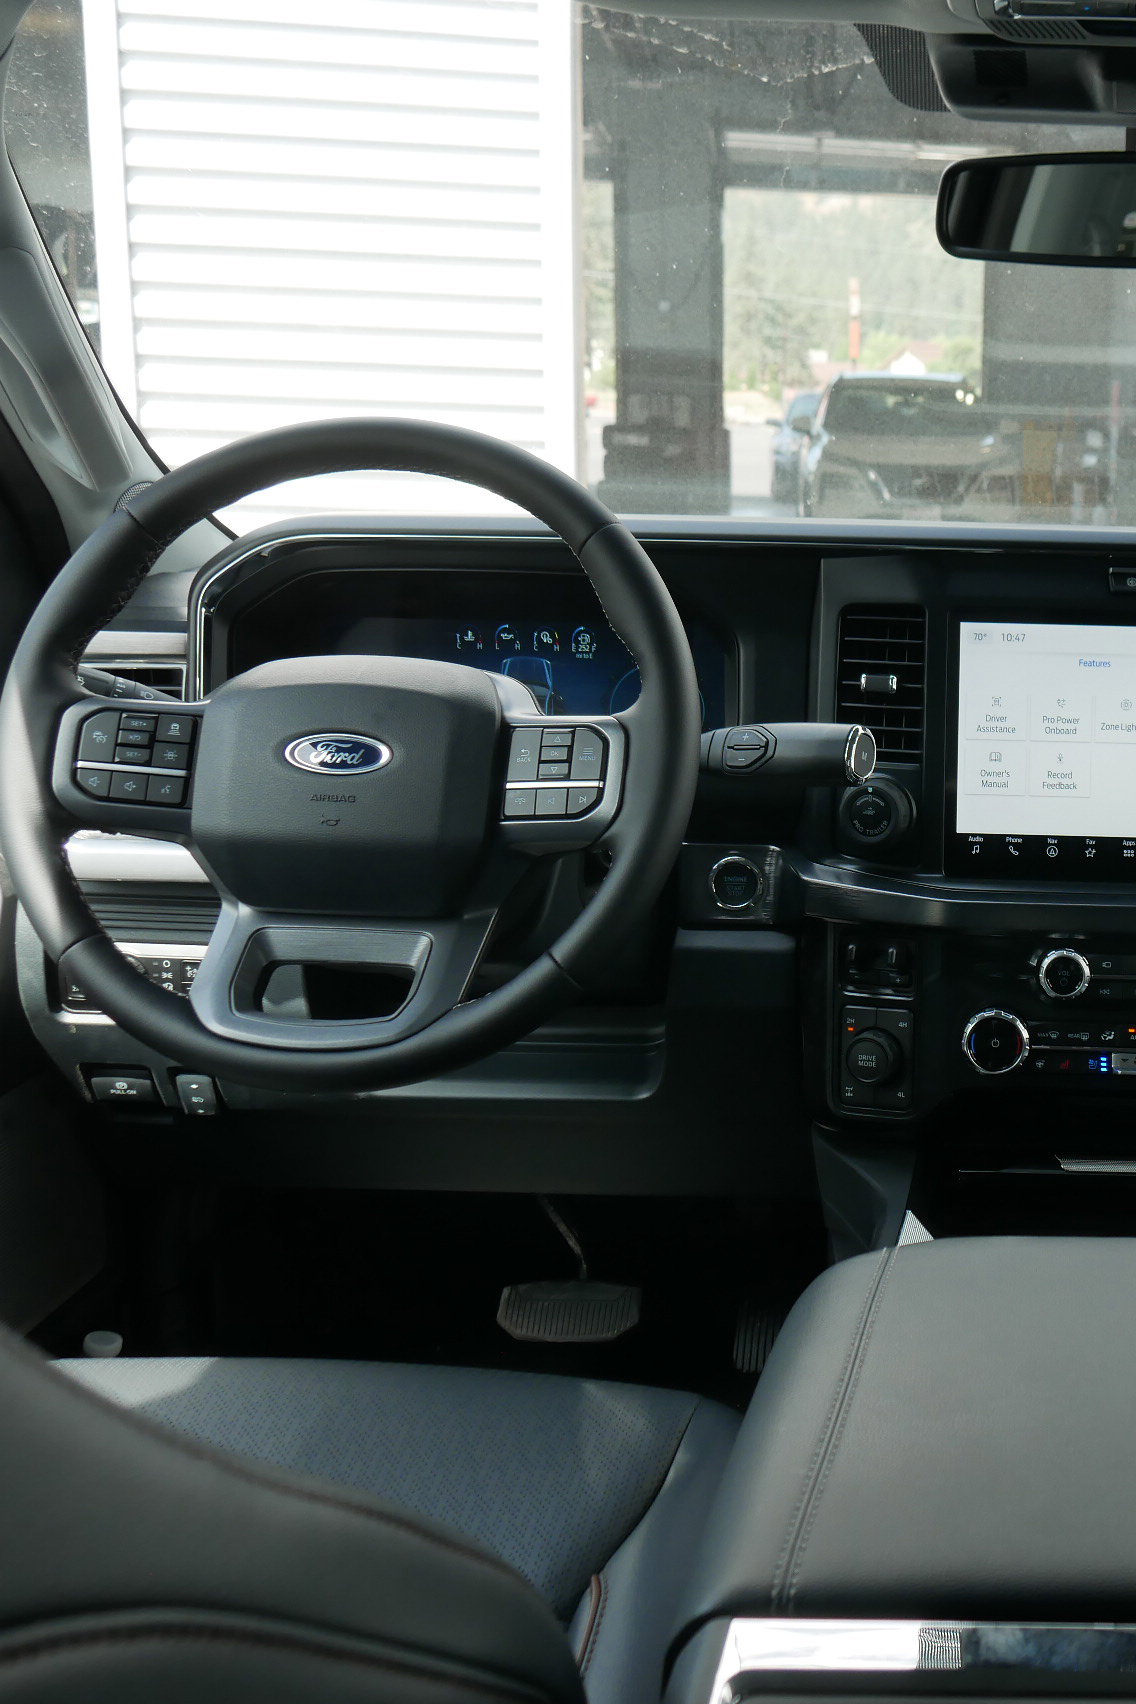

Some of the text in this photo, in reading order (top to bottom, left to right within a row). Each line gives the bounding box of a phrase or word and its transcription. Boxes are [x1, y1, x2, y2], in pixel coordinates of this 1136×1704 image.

[1001, 633, 1026, 642] 10:47
[1078, 659, 1111, 668] Features
[1042, 716, 1080, 725] Pro Power
[976, 725, 1016, 733] Assistance
[1045, 726, 1077, 735] Onboard
[1100, 723, 1120, 731] Zone
[309, 741, 366, 765] Ford
[980, 769, 1010, 778] Owner's
[1047, 771, 1073, 779] Record
[981, 780, 1009, 788] Manual
[1042, 781, 1077, 790] Feedback
[310, 794, 356, 803] AIRBAG
[853, 819, 889, 835] PRO TRAILER
[1122, 839, 1136, 847] Apps
